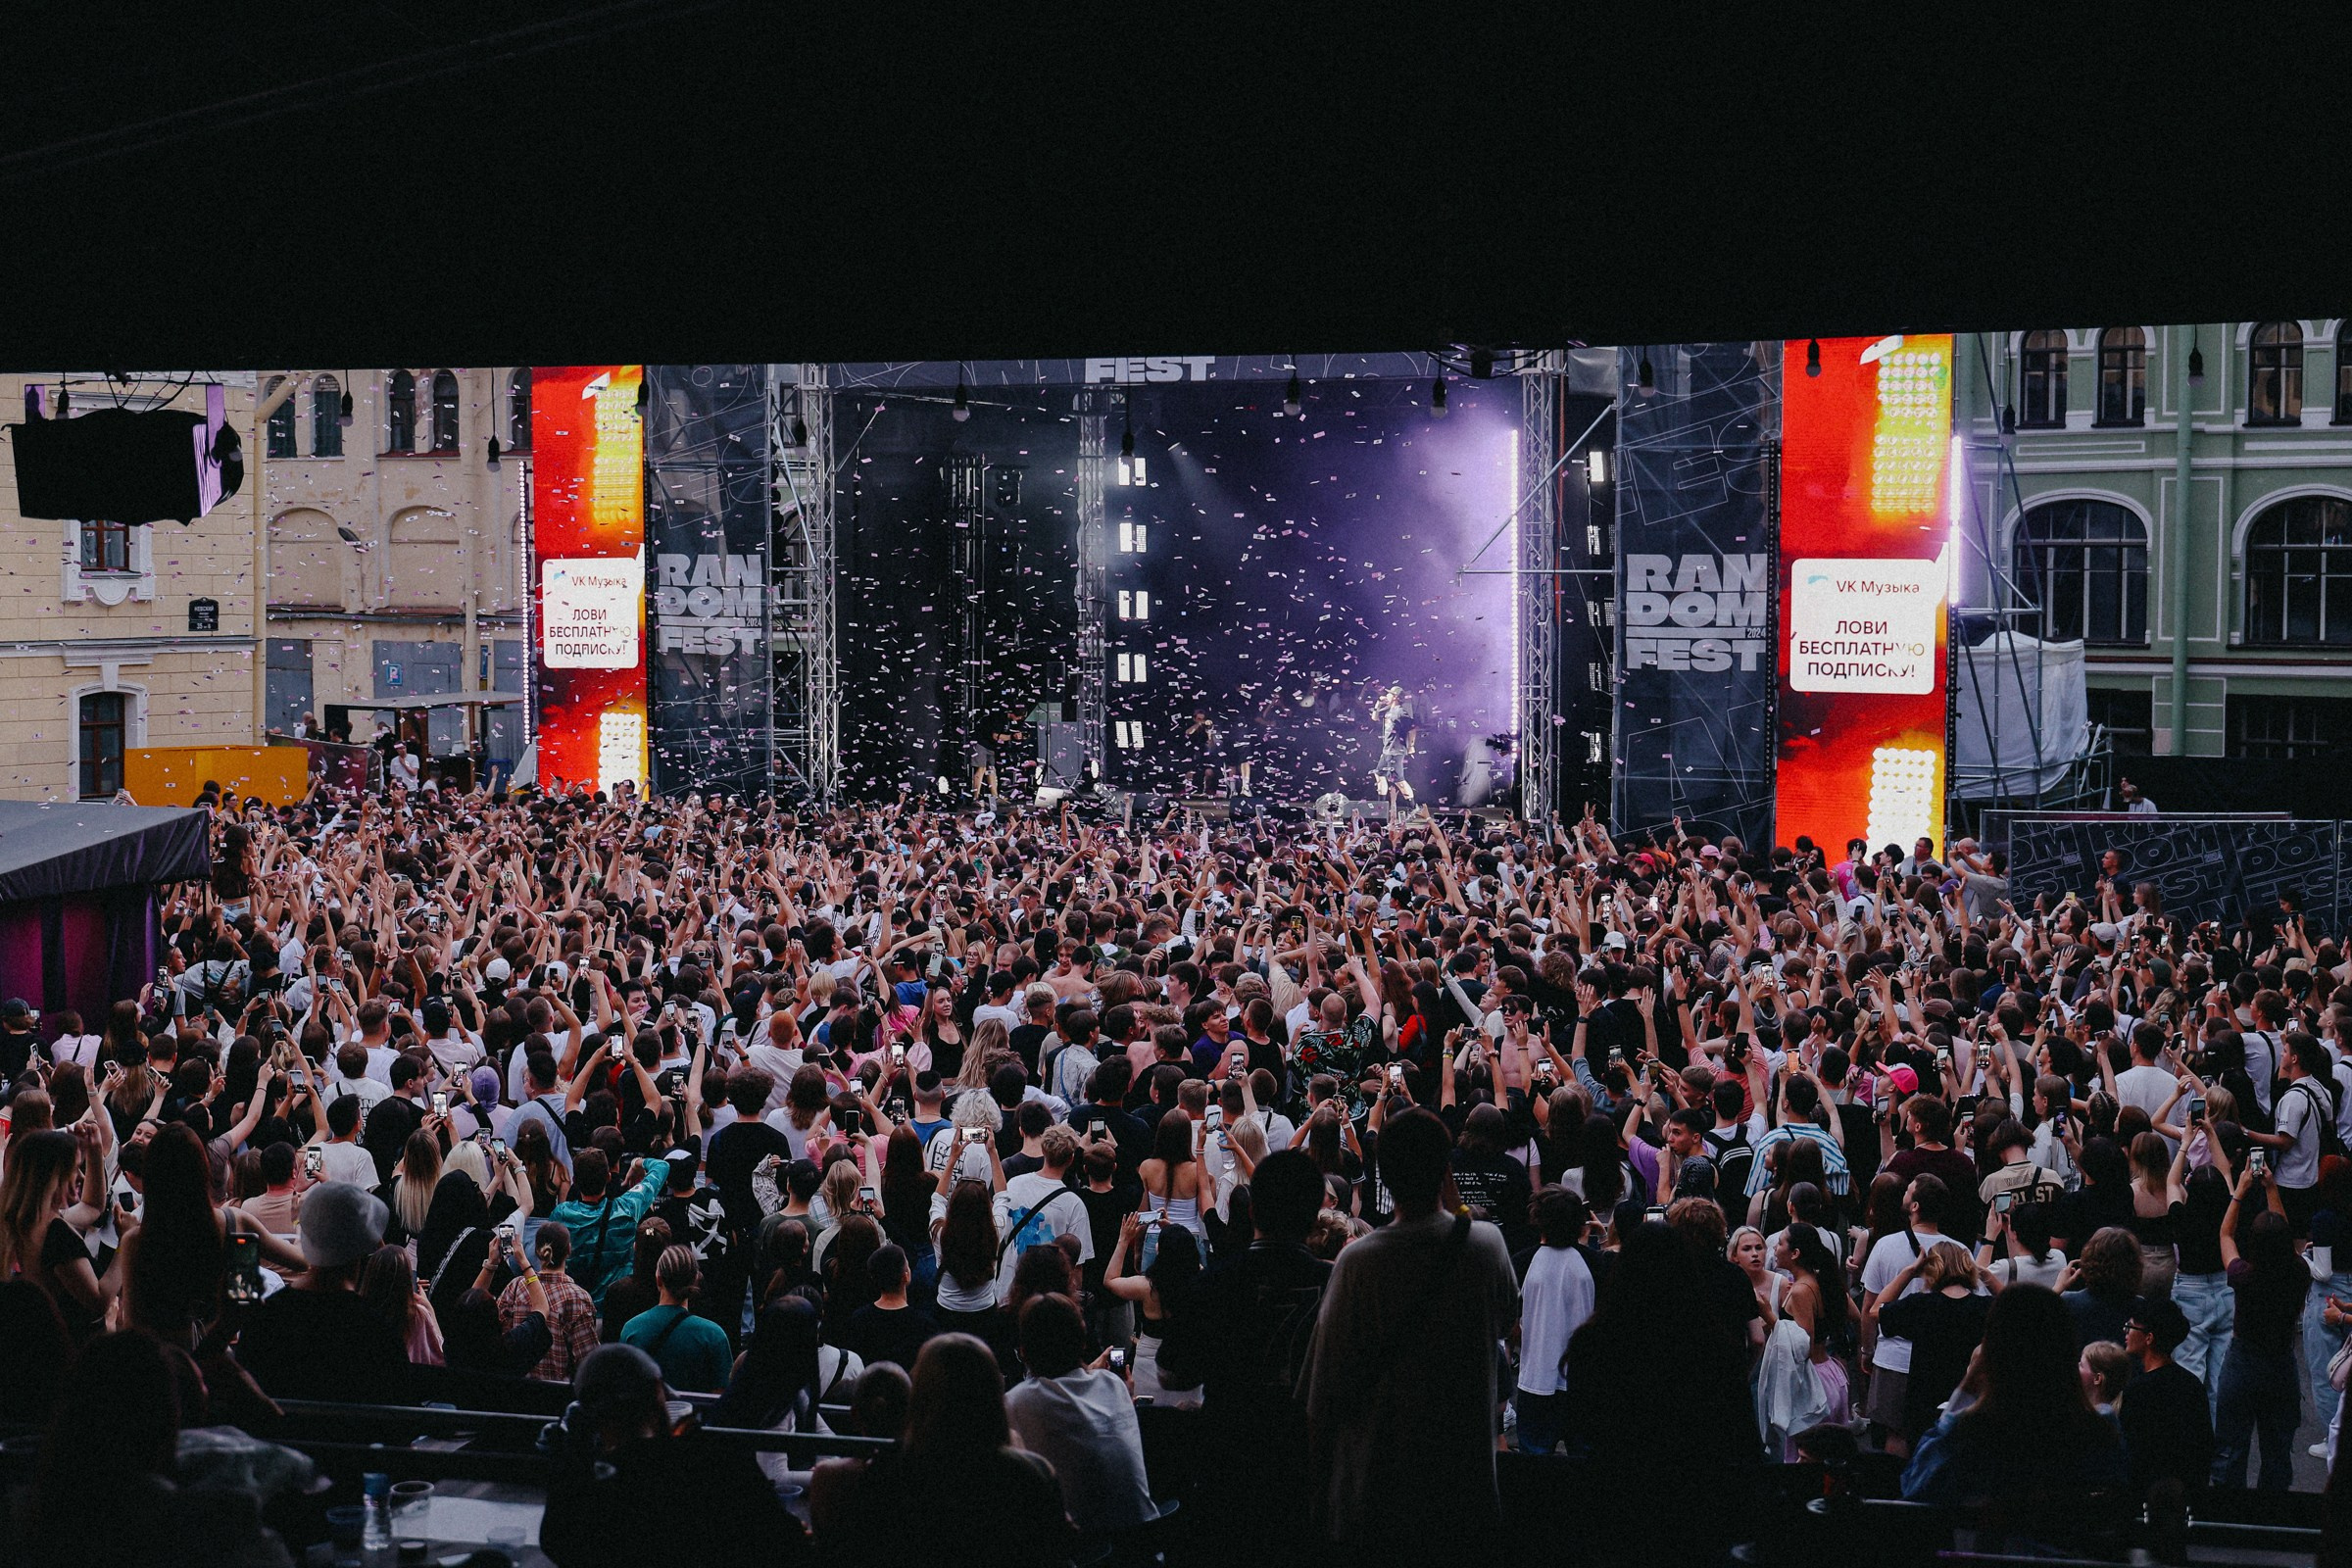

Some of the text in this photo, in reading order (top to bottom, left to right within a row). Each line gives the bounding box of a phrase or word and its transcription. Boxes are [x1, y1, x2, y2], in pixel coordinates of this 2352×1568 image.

[1085, 356, 1215, 383] FEST
[658, 554, 762, 586] RAN
[1627, 554, 1768, 591] RAN
[572, 576, 627, 588] VK Музыка
[1837, 580, 1920, 596] VK Музыка
[658, 586, 761, 617] DOM
[1626, 592, 1767, 627] DOM
[572, 609, 607, 620] ЛОВИ
[746, 617, 762, 627] 2024
[1746, 627, 1767, 638] 2024
[1836, 620, 1887, 635] ЛОВИ
[659, 627, 762, 656] FEST
[1626, 638, 1767, 672] FEST
[1808, 662, 1915, 679] ПОДПИСКУ!
